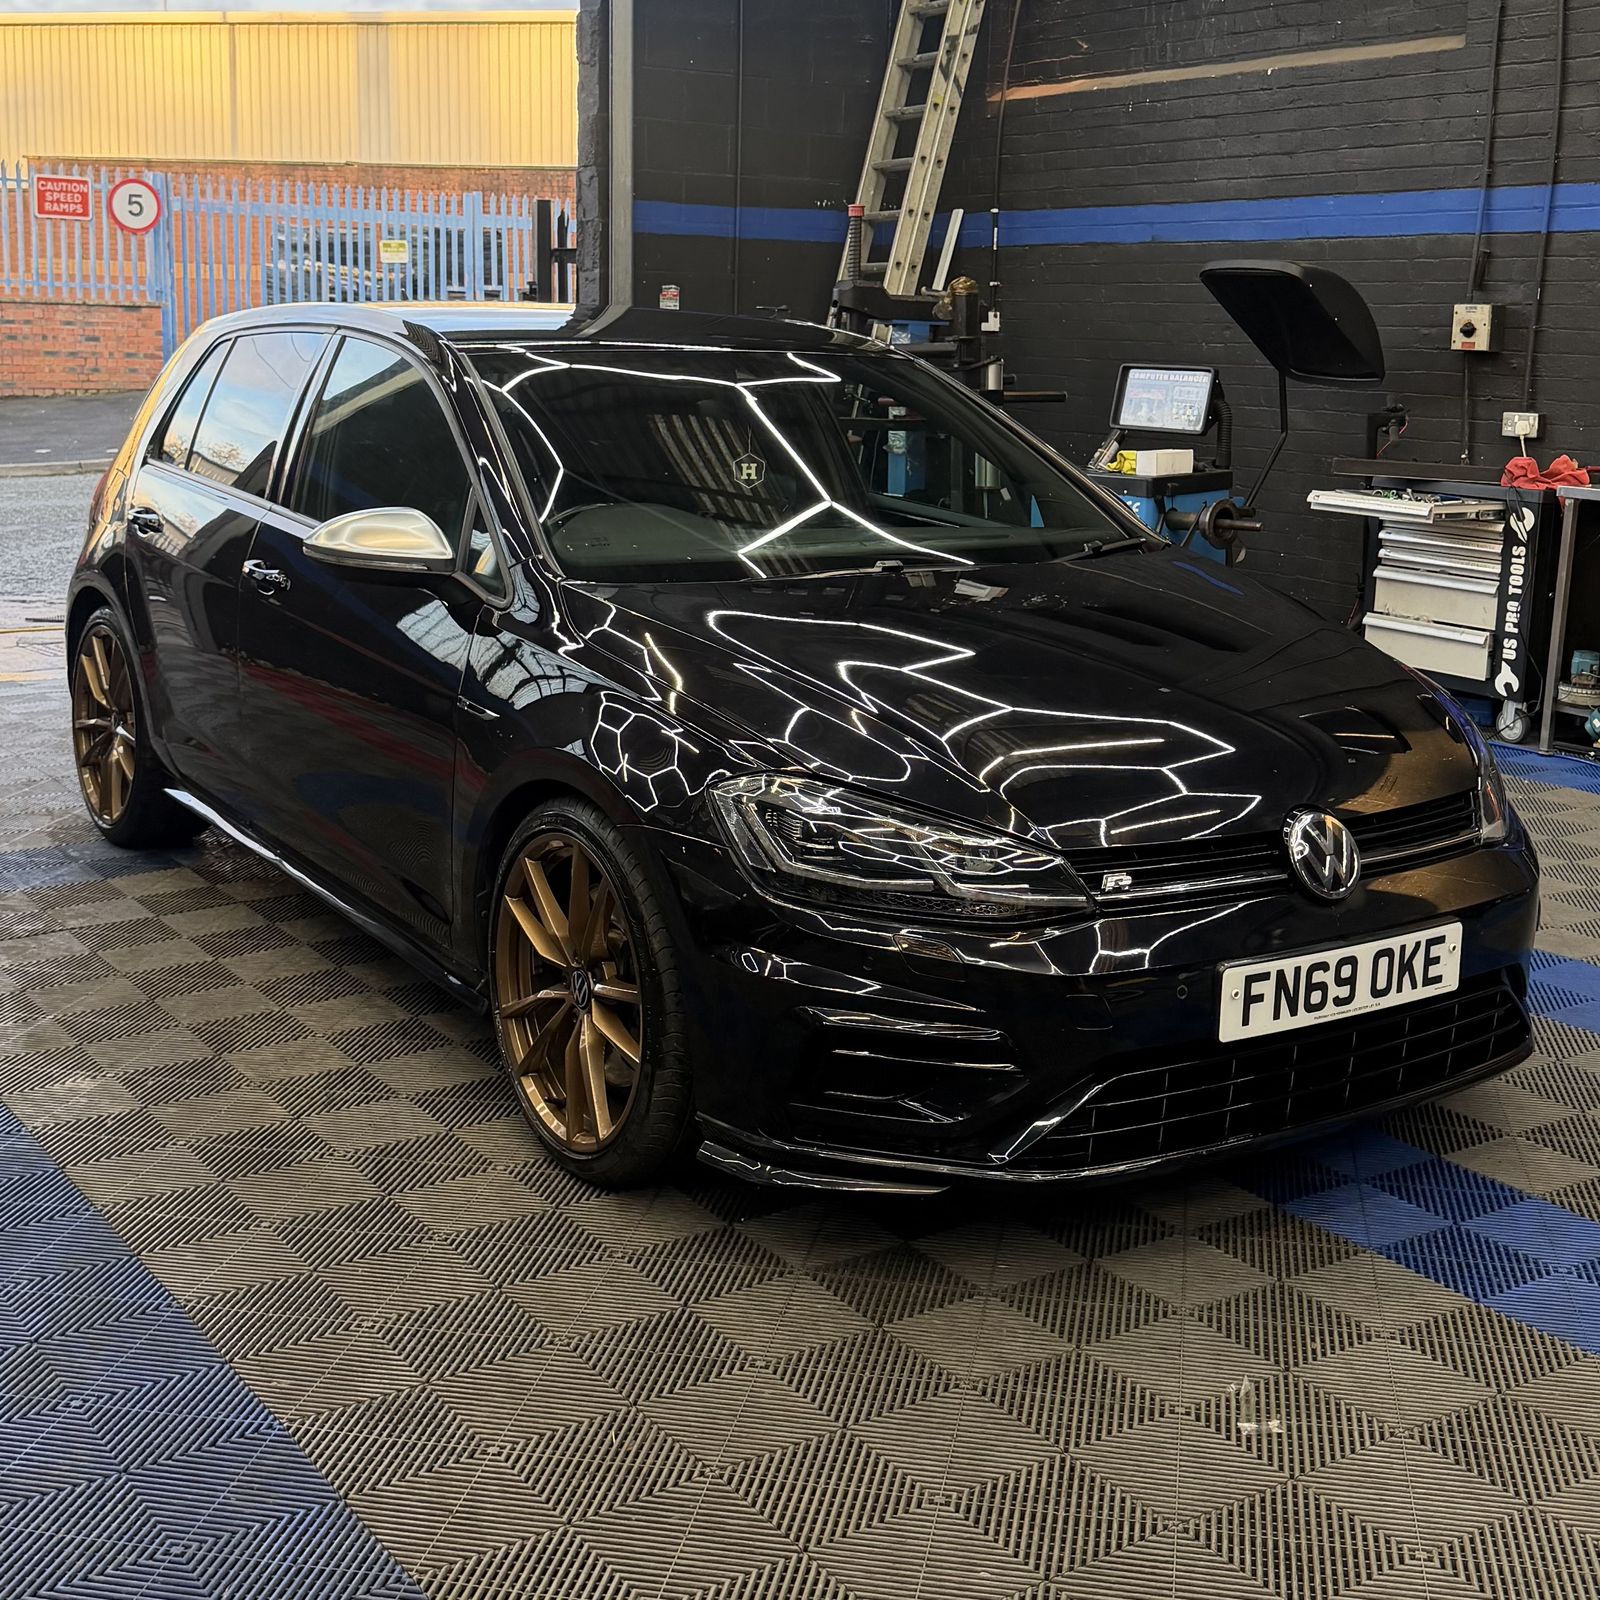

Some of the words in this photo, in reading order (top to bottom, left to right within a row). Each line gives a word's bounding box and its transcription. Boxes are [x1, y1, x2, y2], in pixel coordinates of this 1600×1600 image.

[38, 180, 88, 193] CAUTION
[45, 191, 82, 203] SPEED
[127, 193, 144, 217] 5
[44, 202, 83, 214] RAMPS
[1129, 371, 1168, 381] COMPUTER
[1168, 375, 1209, 383] BALANCER
[740, 463, 757, 480] H
[1508, 545, 1526, 596] TOOLS
[1504, 600, 1521, 634] PRO
[1502, 638, 1518, 661] US
[1241, 955, 1359, 1027] FN69
[1370, 934, 1447, 999] OKE
